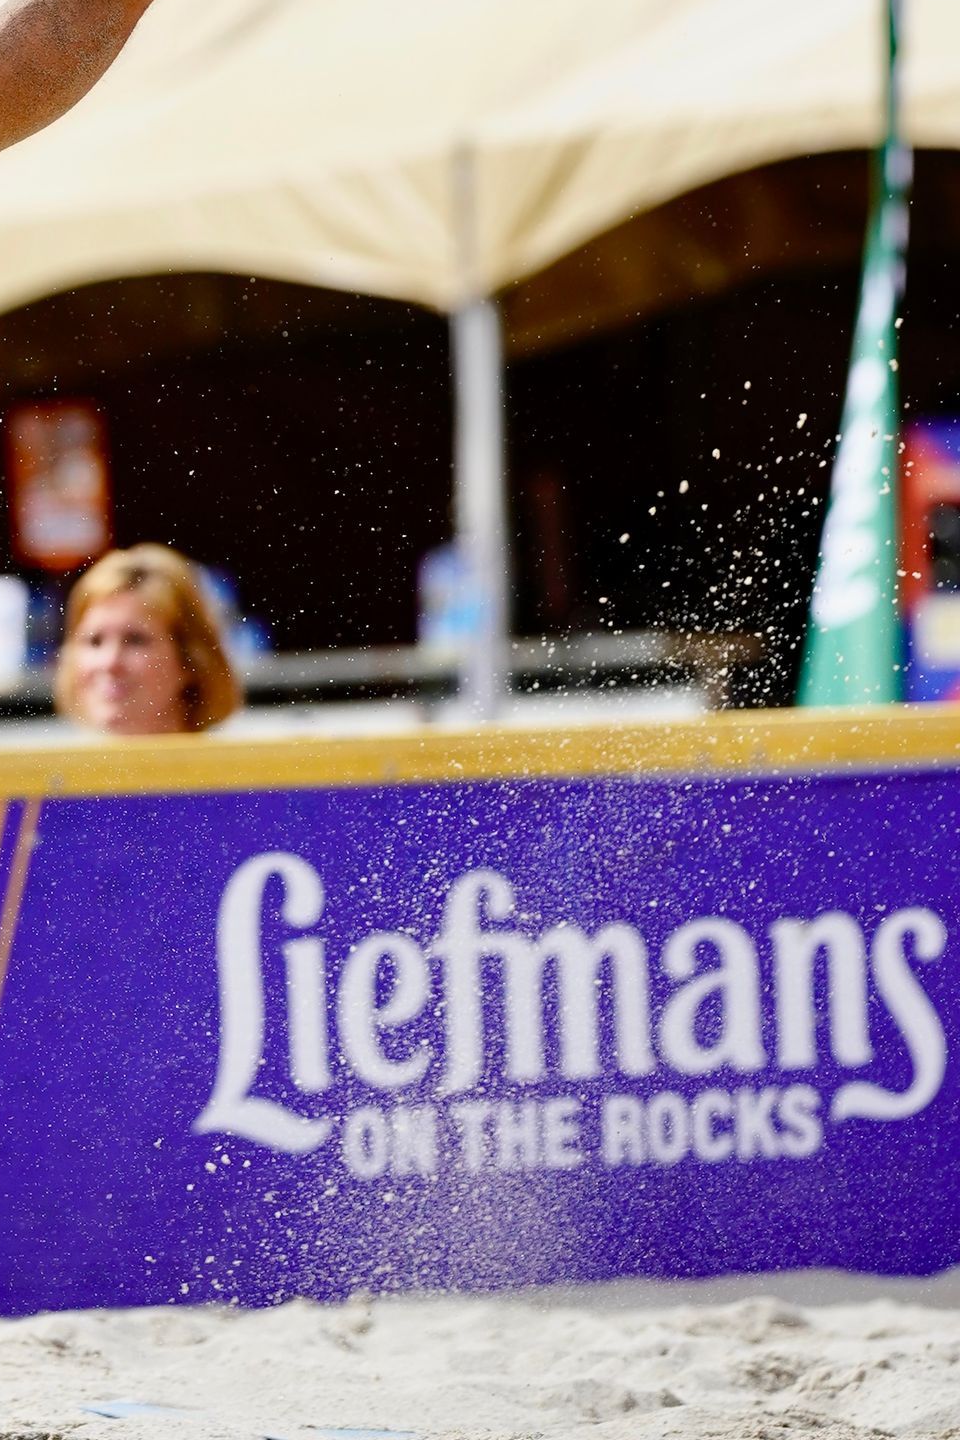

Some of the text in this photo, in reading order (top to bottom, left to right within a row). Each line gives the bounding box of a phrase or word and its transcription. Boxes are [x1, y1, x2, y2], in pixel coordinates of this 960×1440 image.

[194, 851, 947, 1154] Liefmans
[343, 1082, 822, 1180] ON THE ROCKS
